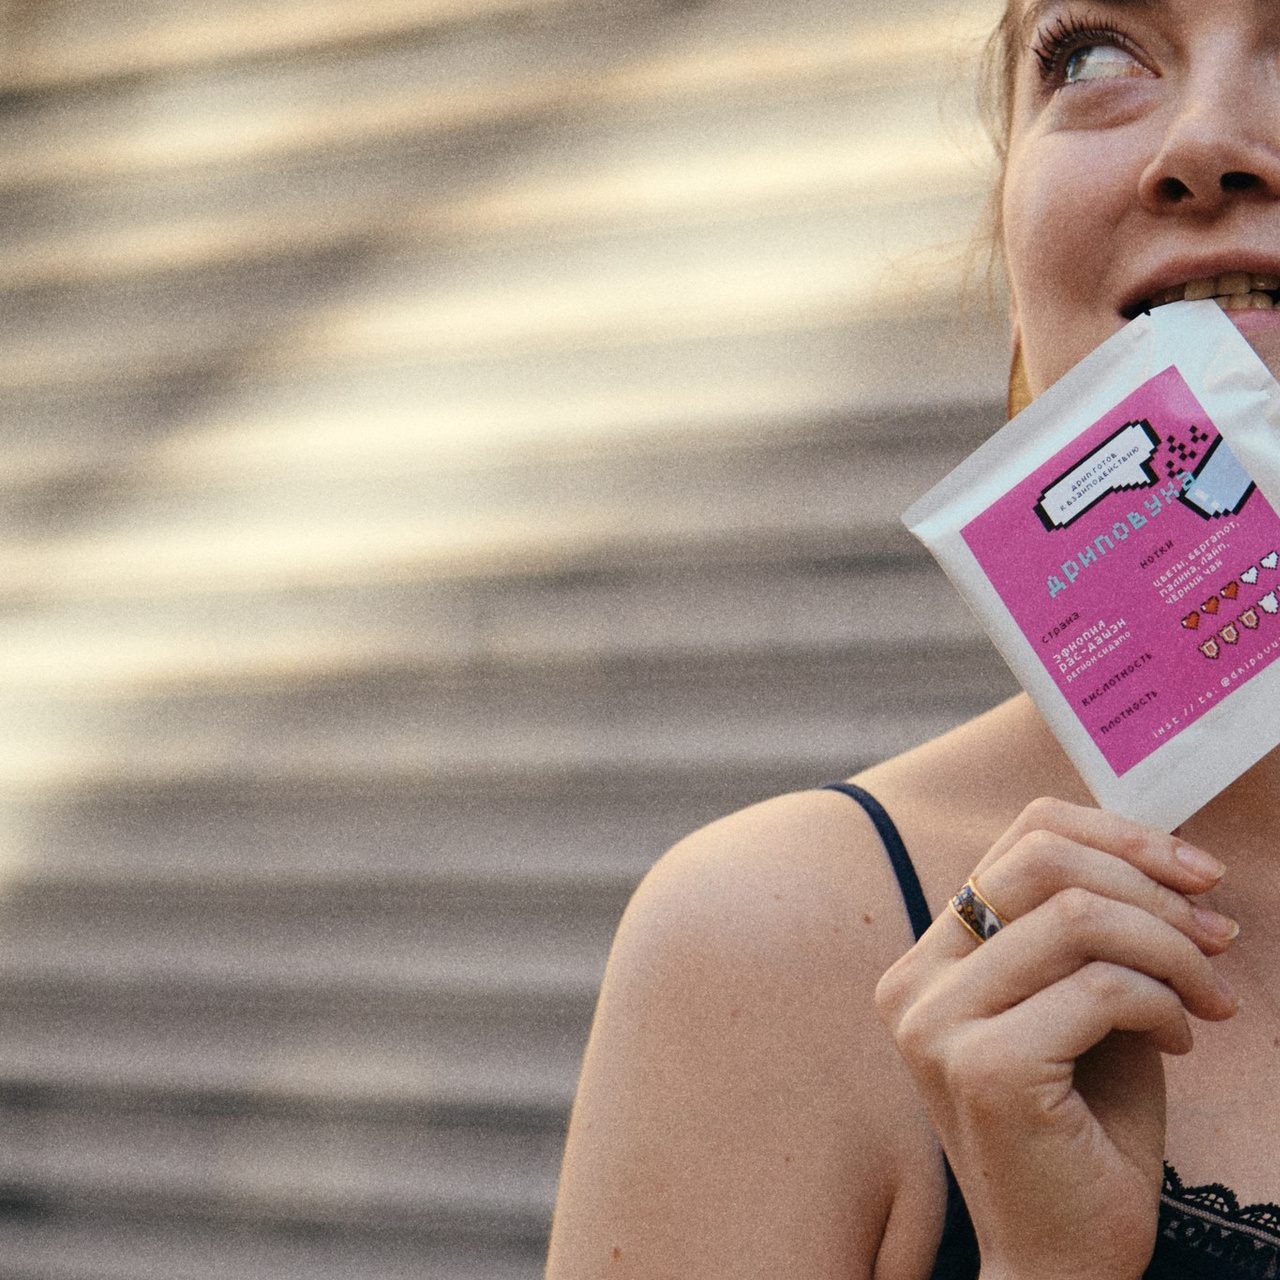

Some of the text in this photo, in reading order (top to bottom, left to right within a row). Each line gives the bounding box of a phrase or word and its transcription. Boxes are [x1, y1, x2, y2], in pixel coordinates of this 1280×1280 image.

[1069, 451, 1117, 492] дрип готов
[1041, 467, 1197, 599] дриповуха
[1138, 539, 1174, 569] нотки
[1202, 557, 1224, 577] чай
[1040, 610, 1081, 645] страна
[1052, 618, 1106, 664] эфиопия
[1057, 616, 1127, 673] рас-дашэн
[1065, 654, 1098, 683] регион
[1080, 650, 1152, 707] кислотность
[1099, 687, 1158, 735] плотность
